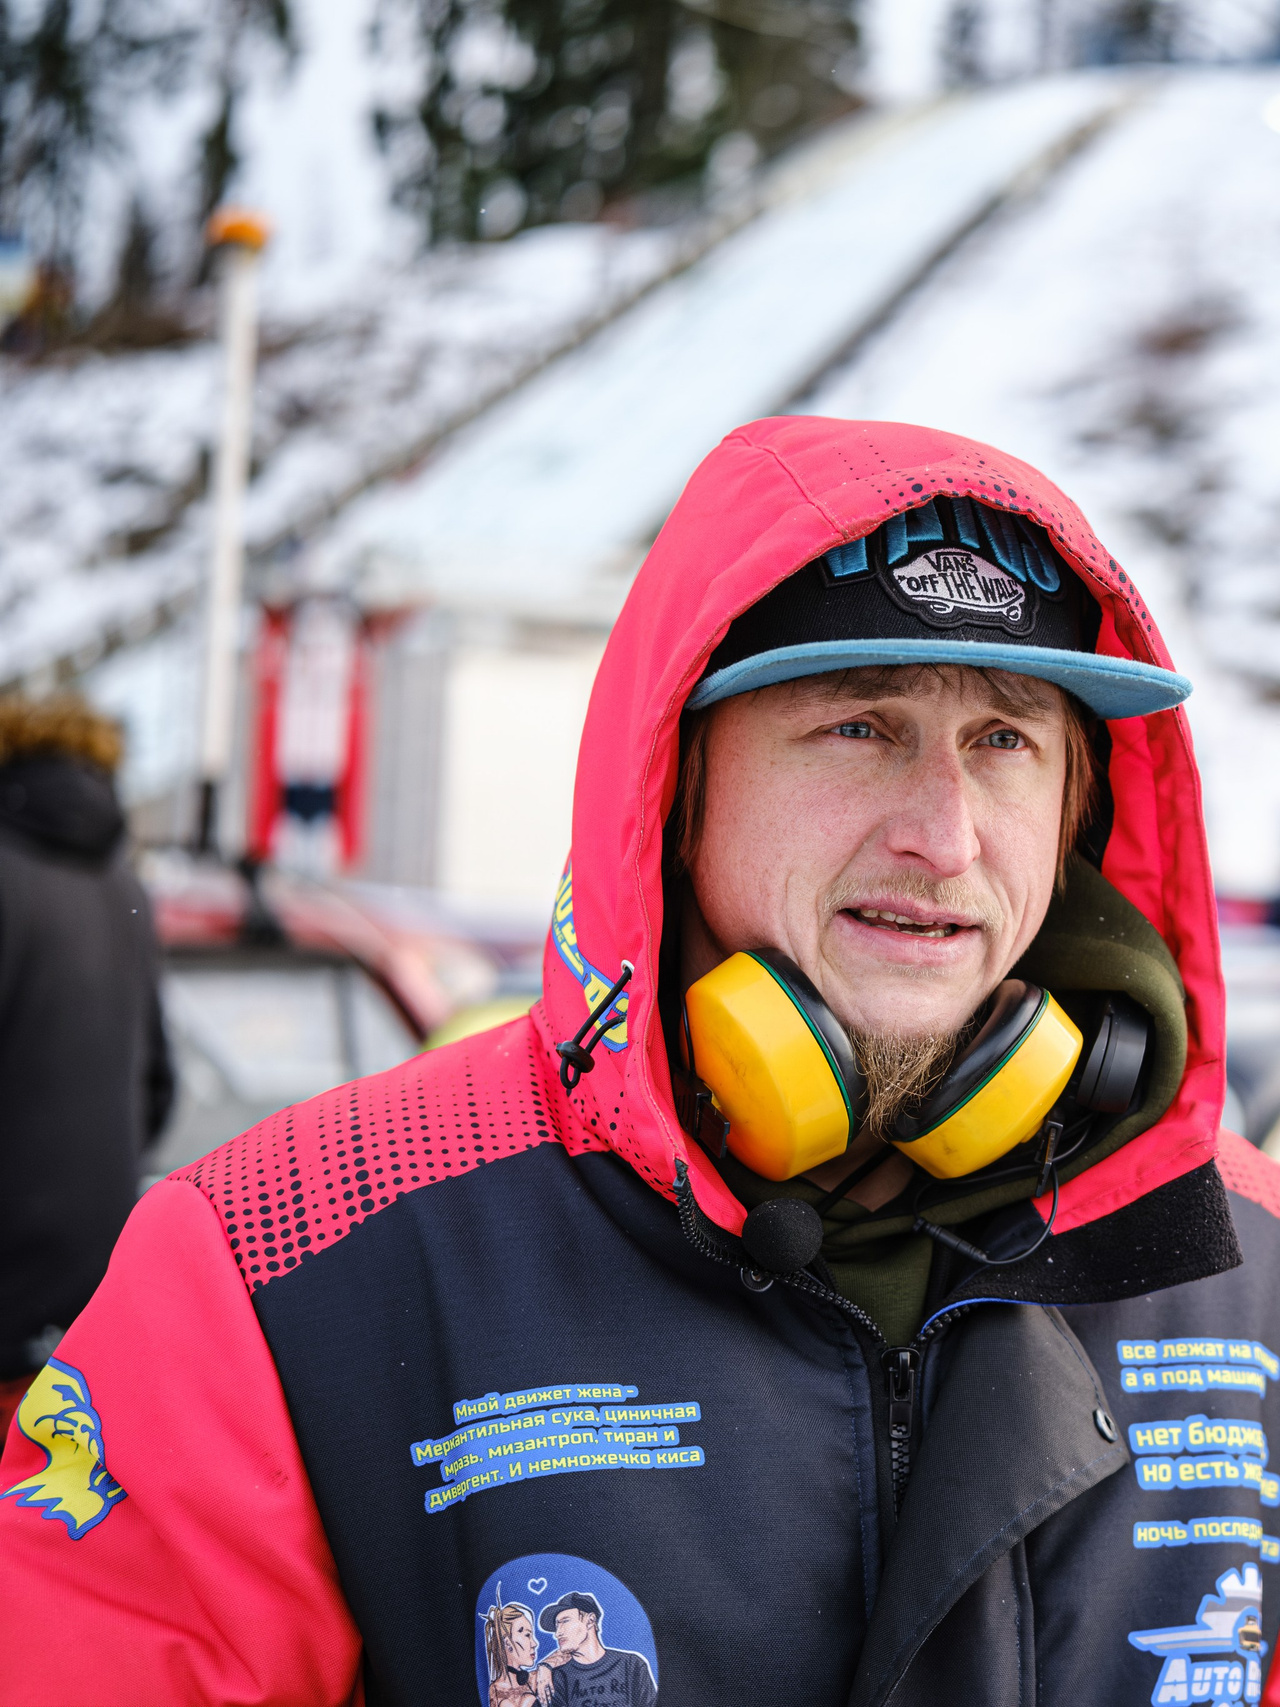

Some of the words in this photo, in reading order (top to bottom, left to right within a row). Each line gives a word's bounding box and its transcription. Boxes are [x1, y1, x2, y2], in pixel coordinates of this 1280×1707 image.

[923, 551, 978, 574] VANS
[938, 571, 982, 601] THE
[1121, 1344, 1157, 1360] все
[1162, 1342, 1225, 1359] лежат
[1228, 1344, 1252, 1359] на
[1125, 1372, 1138, 1387] а
[1142, 1372, 1157, 1387] я
[1162, 1369, 1204, 1386] под
[455, 1397, 499, 1420] Мной
[504, 1388, 572, 1411] движет
[577, 1386, 623, 1399] жена
[415, 1414, 545, 1462] Меркантильная
[551, 1409, 600, 1426] сука,
[605, 1405, 697, 1423] циничная
[1135, 1427, 1183, 1447] нет
[444, 1453, 484, 1477] мразь,
[488, 1430, 599, 1459] мизантроп,
[604, 1428, 658, 1445] тиран
[663, 1428, 676, 1442] и
[508, 1461, 522, 1478] И
[528, 1451, 651, 1474] немножечко
[656, 1450, 701, 1465] киса
[1142, 1463, 1172, 1483] но
[1179, 1460, 1240, 1482] есть
[1137, 1525, 1188, 1542] ночь
